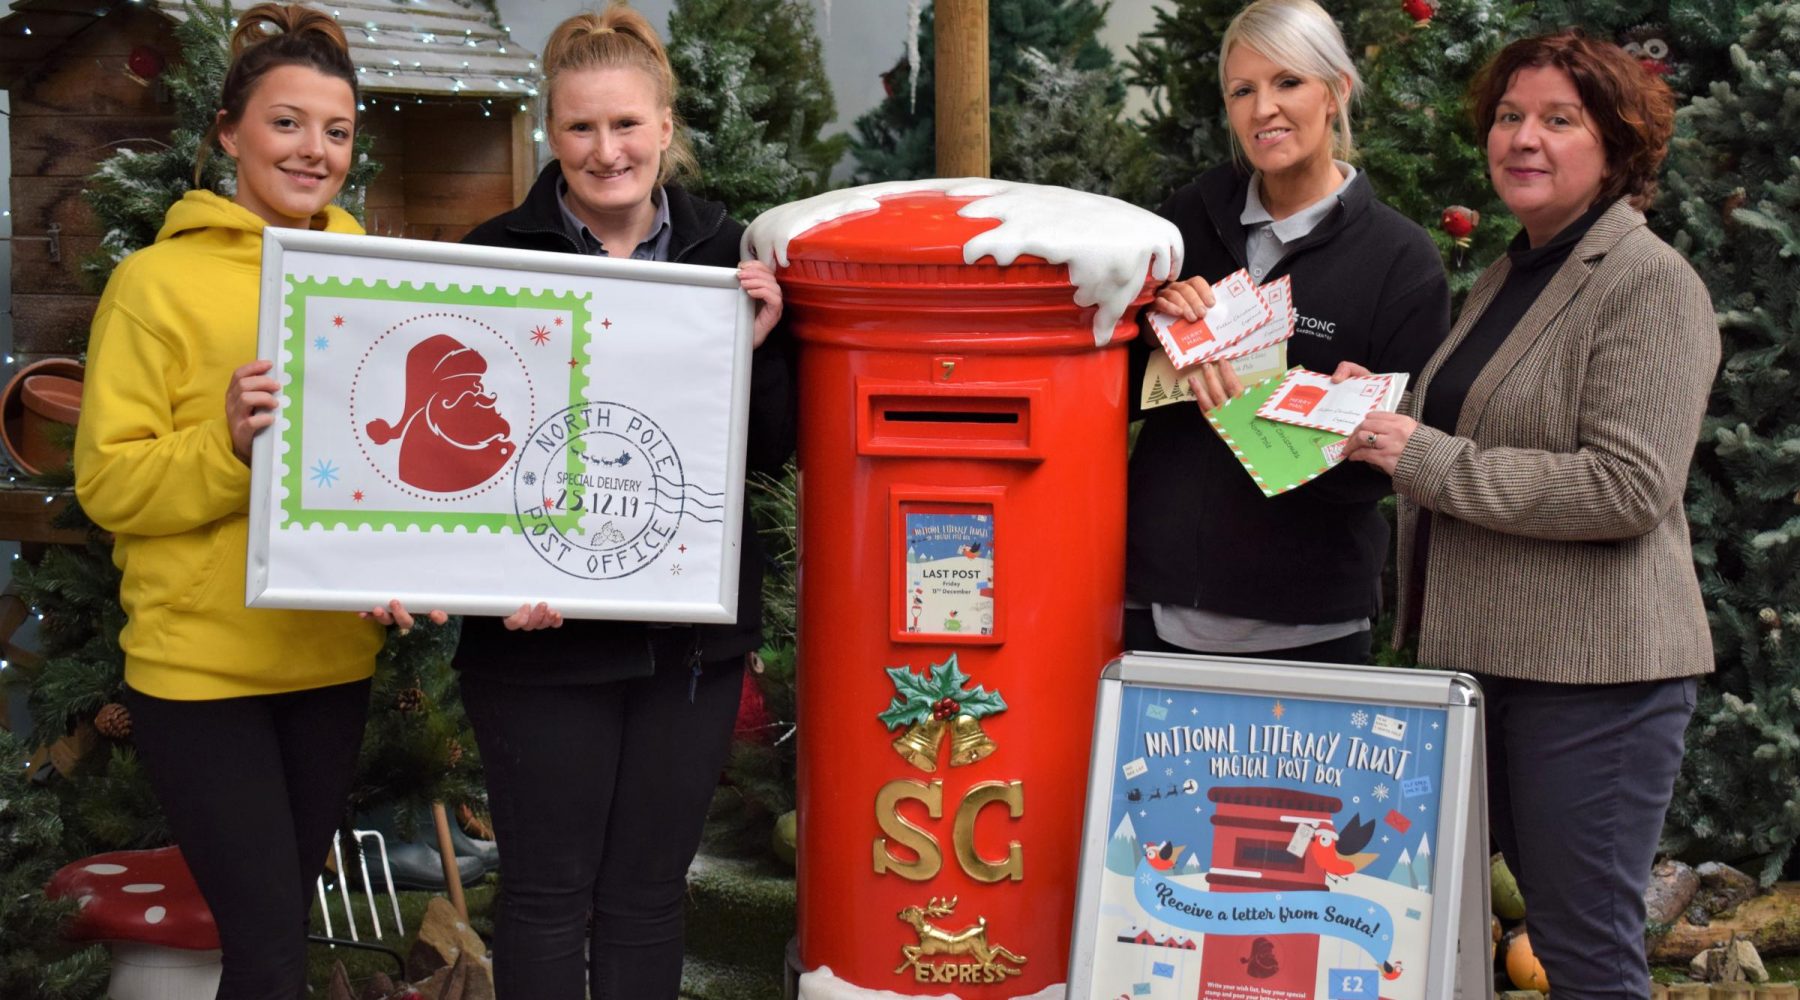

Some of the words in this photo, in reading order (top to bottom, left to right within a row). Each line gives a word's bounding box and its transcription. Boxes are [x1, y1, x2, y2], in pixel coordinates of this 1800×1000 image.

[1300, 316, 1336, 334] TONG
[941, 362, 955, 380] 7
[536, 408, 611, 453] NORTH
[625, 416, 675, 472] POLE
[556, 472, 595, 487] SPECIAL
[597, 476, 642, 493] DELIVERY
[555, 487, 639, 519] 25.12.19
[523, 506, 572, 562] POST
[586, 519, 671, 574] OFFICE
[923, 569, 950, 579] LAST
[952, 570, 981, 579] POST
[1144, 723, 1239, 758] NATIONAL
[1249, 723, 1341, 764] LITERACY
[1347, 736, 1413, 781] TRUST
[1210, 754, 1270, 779] MAGICAL
[1276, 756, 1311, 783] POST
[1314, 763, 1344, 787] BOX
[1155, 881, 1214, 920] Receive
[1217, 908, 1228, 921] a
[1232, 905, 1276, 921] letter
[1278, 906, 1320, 924] from
[1323, 906, 1381, 938] Santa!
[915, 963, 1008, 983] EXPRESS
[1236, 984, 1249, 992] wish
[1261, 987, 1271, 995] buy
[1272, 989, 1285, 997] your
[1286, 991, 1306, 999] special
[1342, 975, 1364, 993] £2
[1205, 990, 1221, 998] stamp
[1233, 992, 1245, 1000] post
